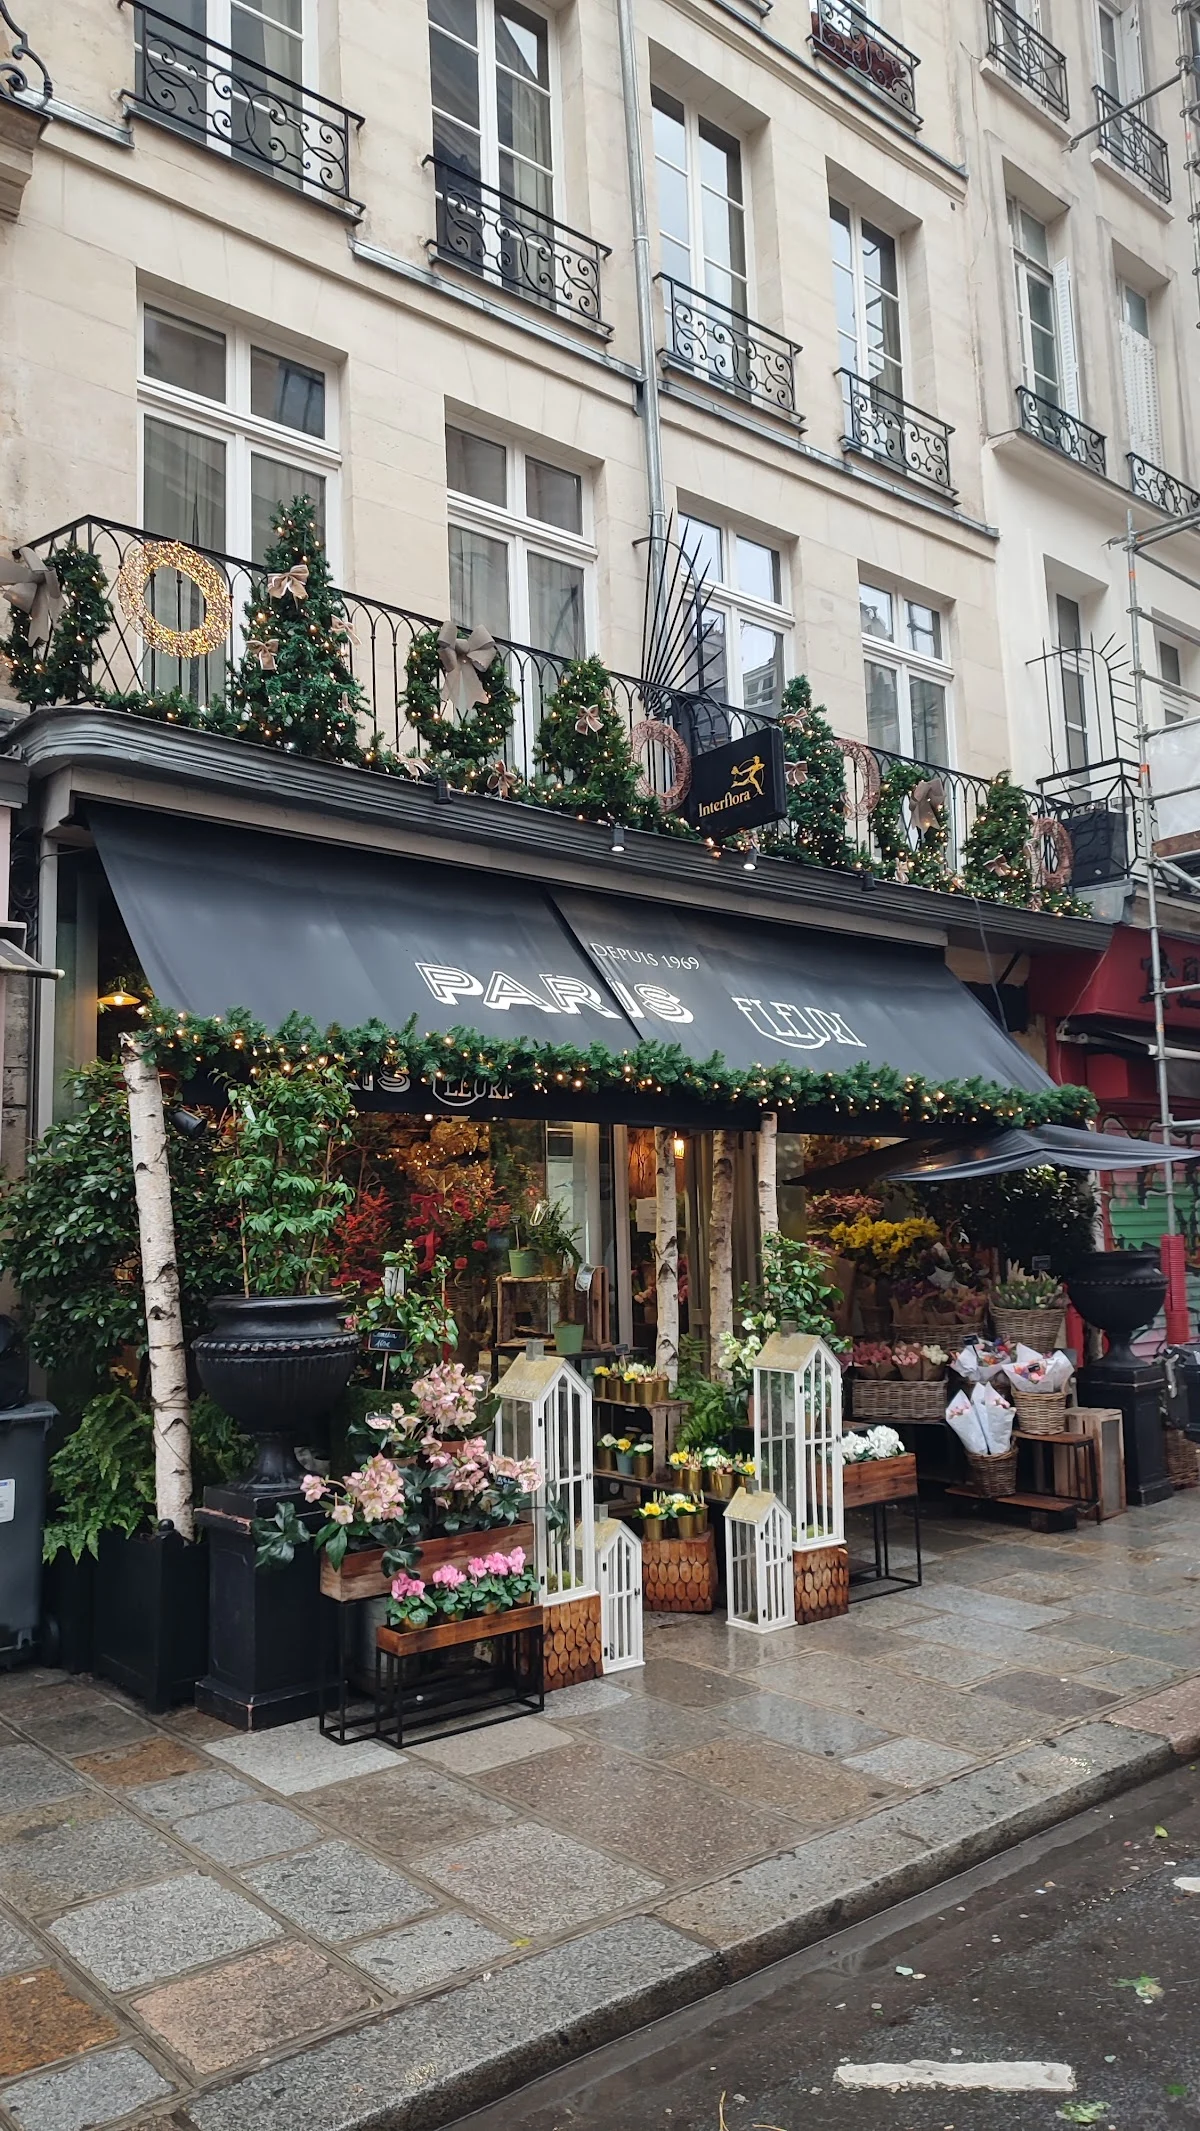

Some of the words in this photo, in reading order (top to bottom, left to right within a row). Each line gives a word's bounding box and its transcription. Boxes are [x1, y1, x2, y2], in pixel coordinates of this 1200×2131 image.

[698, 790, 751, 818] Interflora
[590, 943, 659, 966] DEPUIS
[661, 955, 700, 970] 1969
[415, 962, 694, 1024] PARIS
[731, 996, 867, 1050] FLEURI
